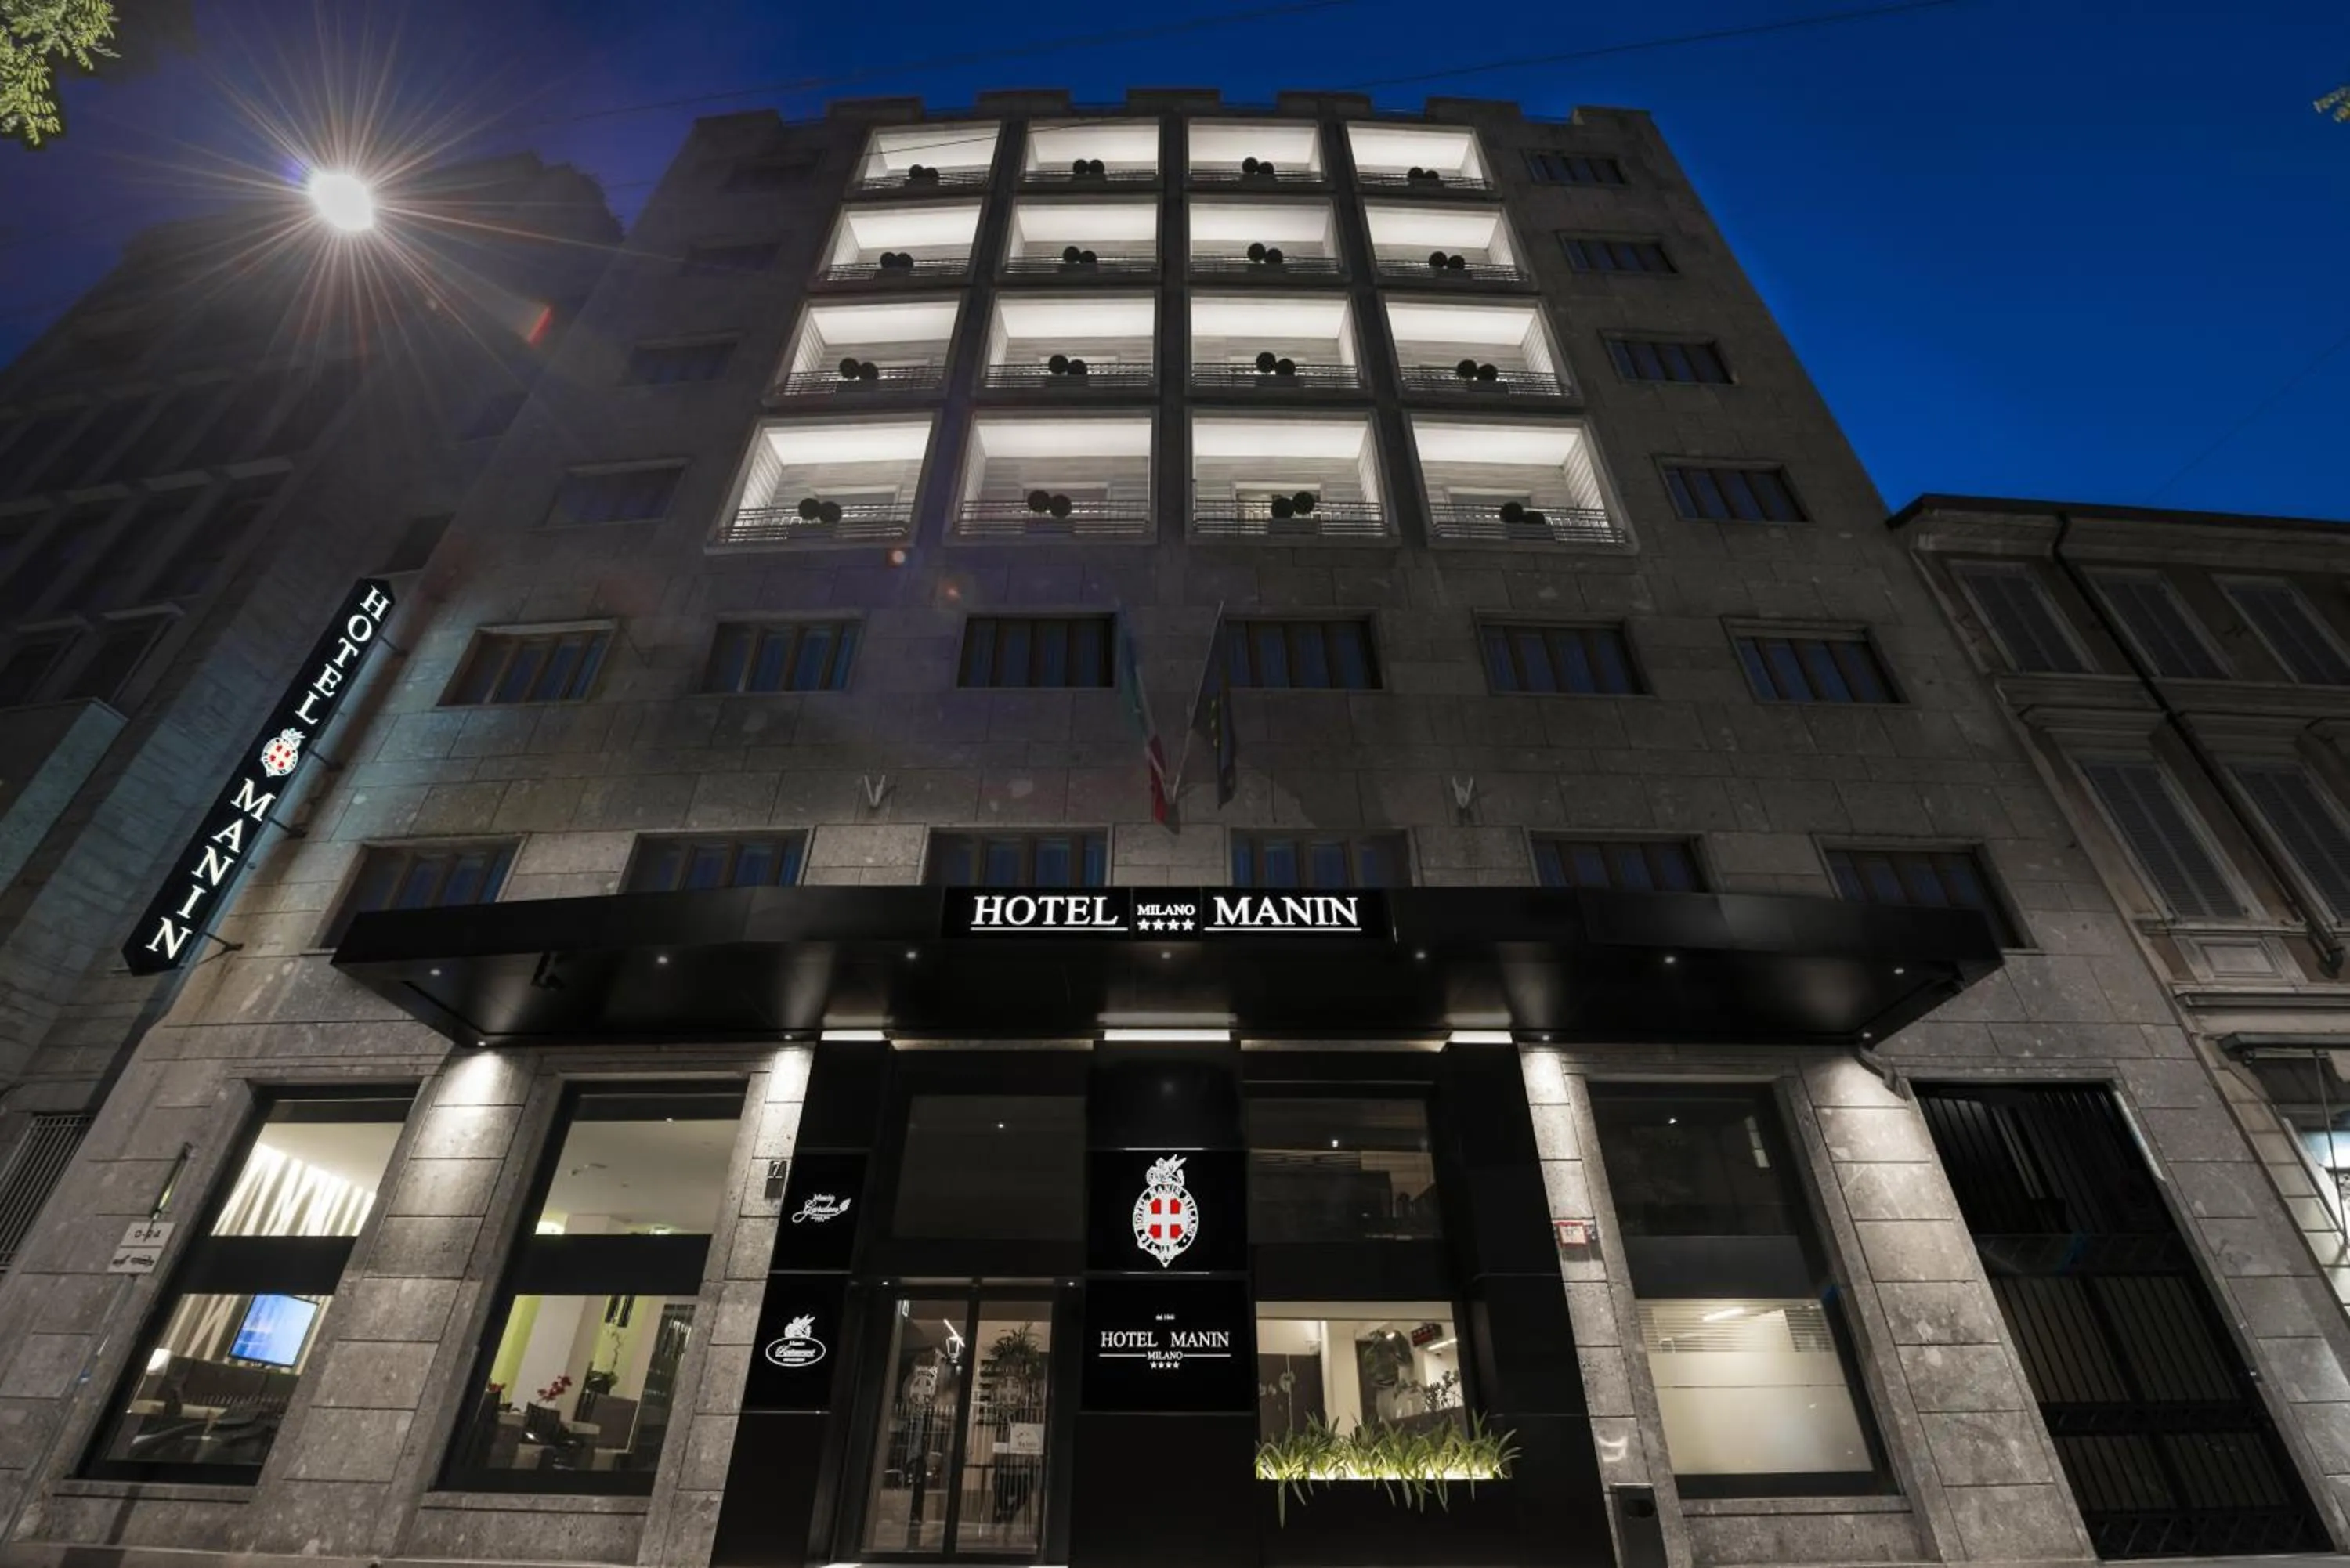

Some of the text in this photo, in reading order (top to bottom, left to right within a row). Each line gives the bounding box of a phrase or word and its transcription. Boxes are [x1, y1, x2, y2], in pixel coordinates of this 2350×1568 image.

[146, 586, 389, 959] HOTEL MANIN
[971, 895, 1359, 926] HOTEL MILANO MANIN
[772, 1162, 781, 1176] 7
[1101, 1331, 1229, 1348] HOTEL MANIN
[1147, 1351, 1184, 1360] MILANO
